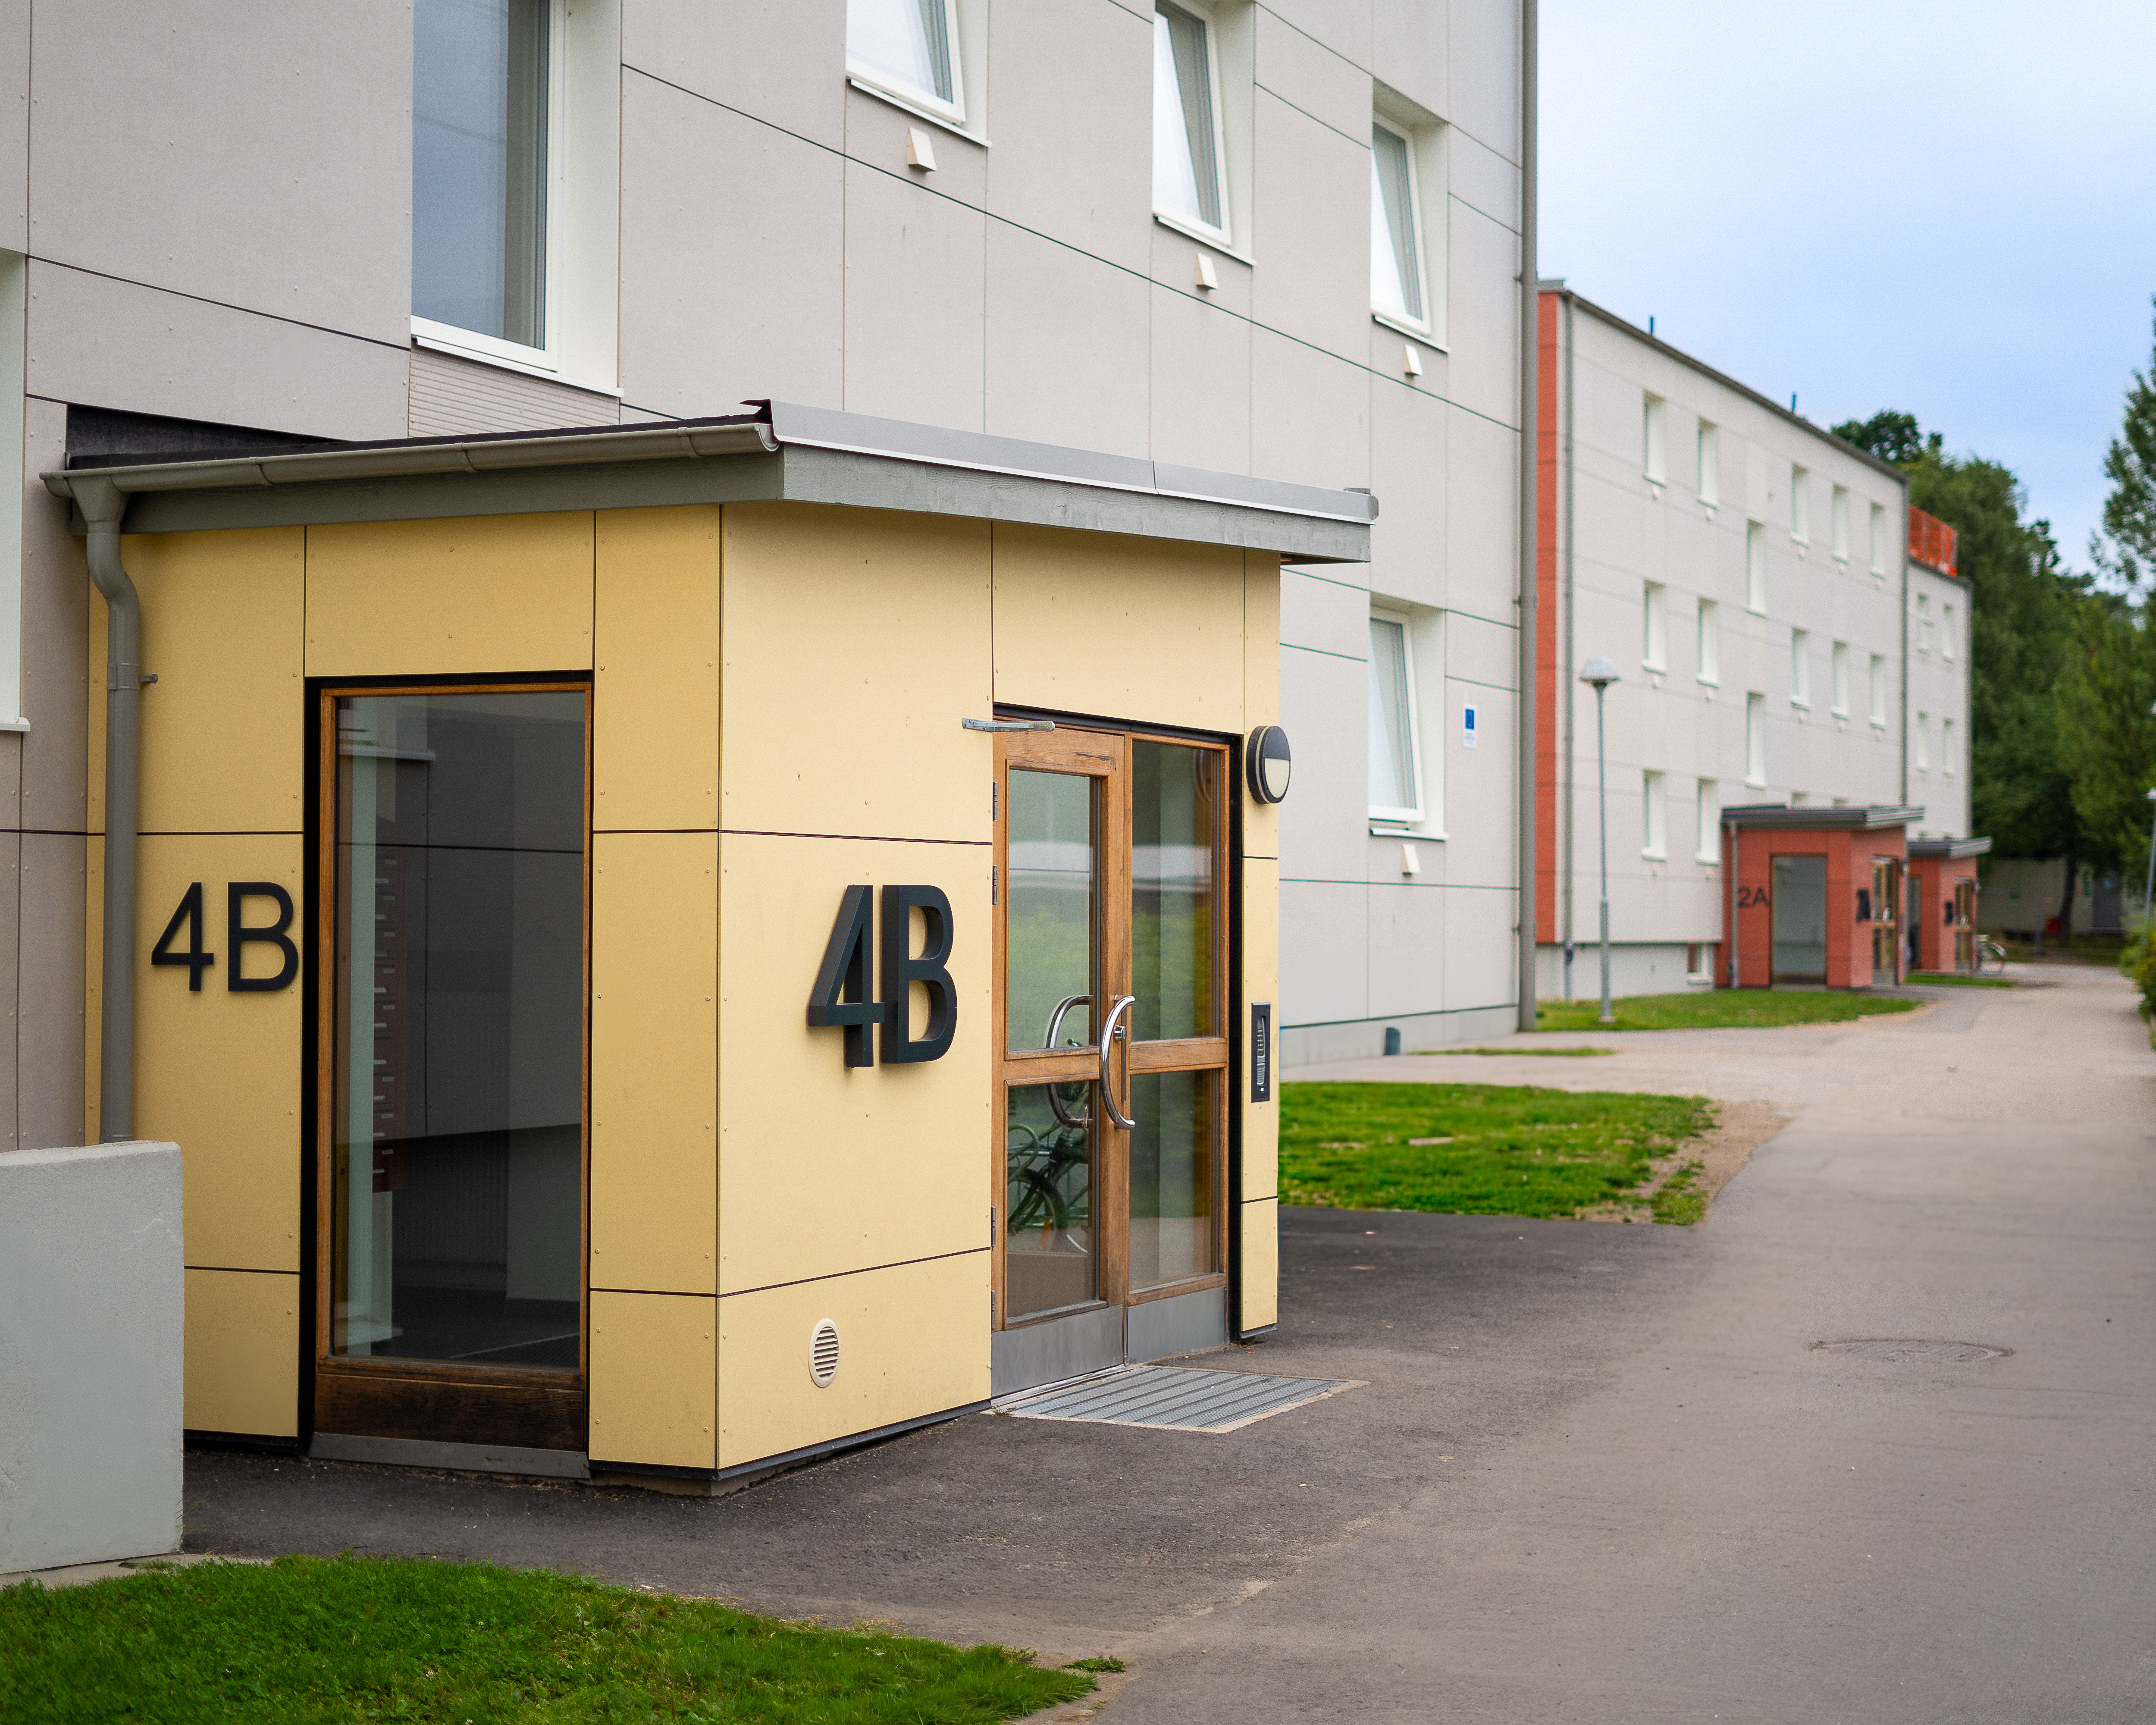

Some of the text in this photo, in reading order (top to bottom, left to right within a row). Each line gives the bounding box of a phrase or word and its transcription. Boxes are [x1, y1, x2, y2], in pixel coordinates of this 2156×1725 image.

[151, 881, 299, 992] 4B
[1738, 886, 1769, 907] 2A
[808, 884, 958, 1068] 4B
